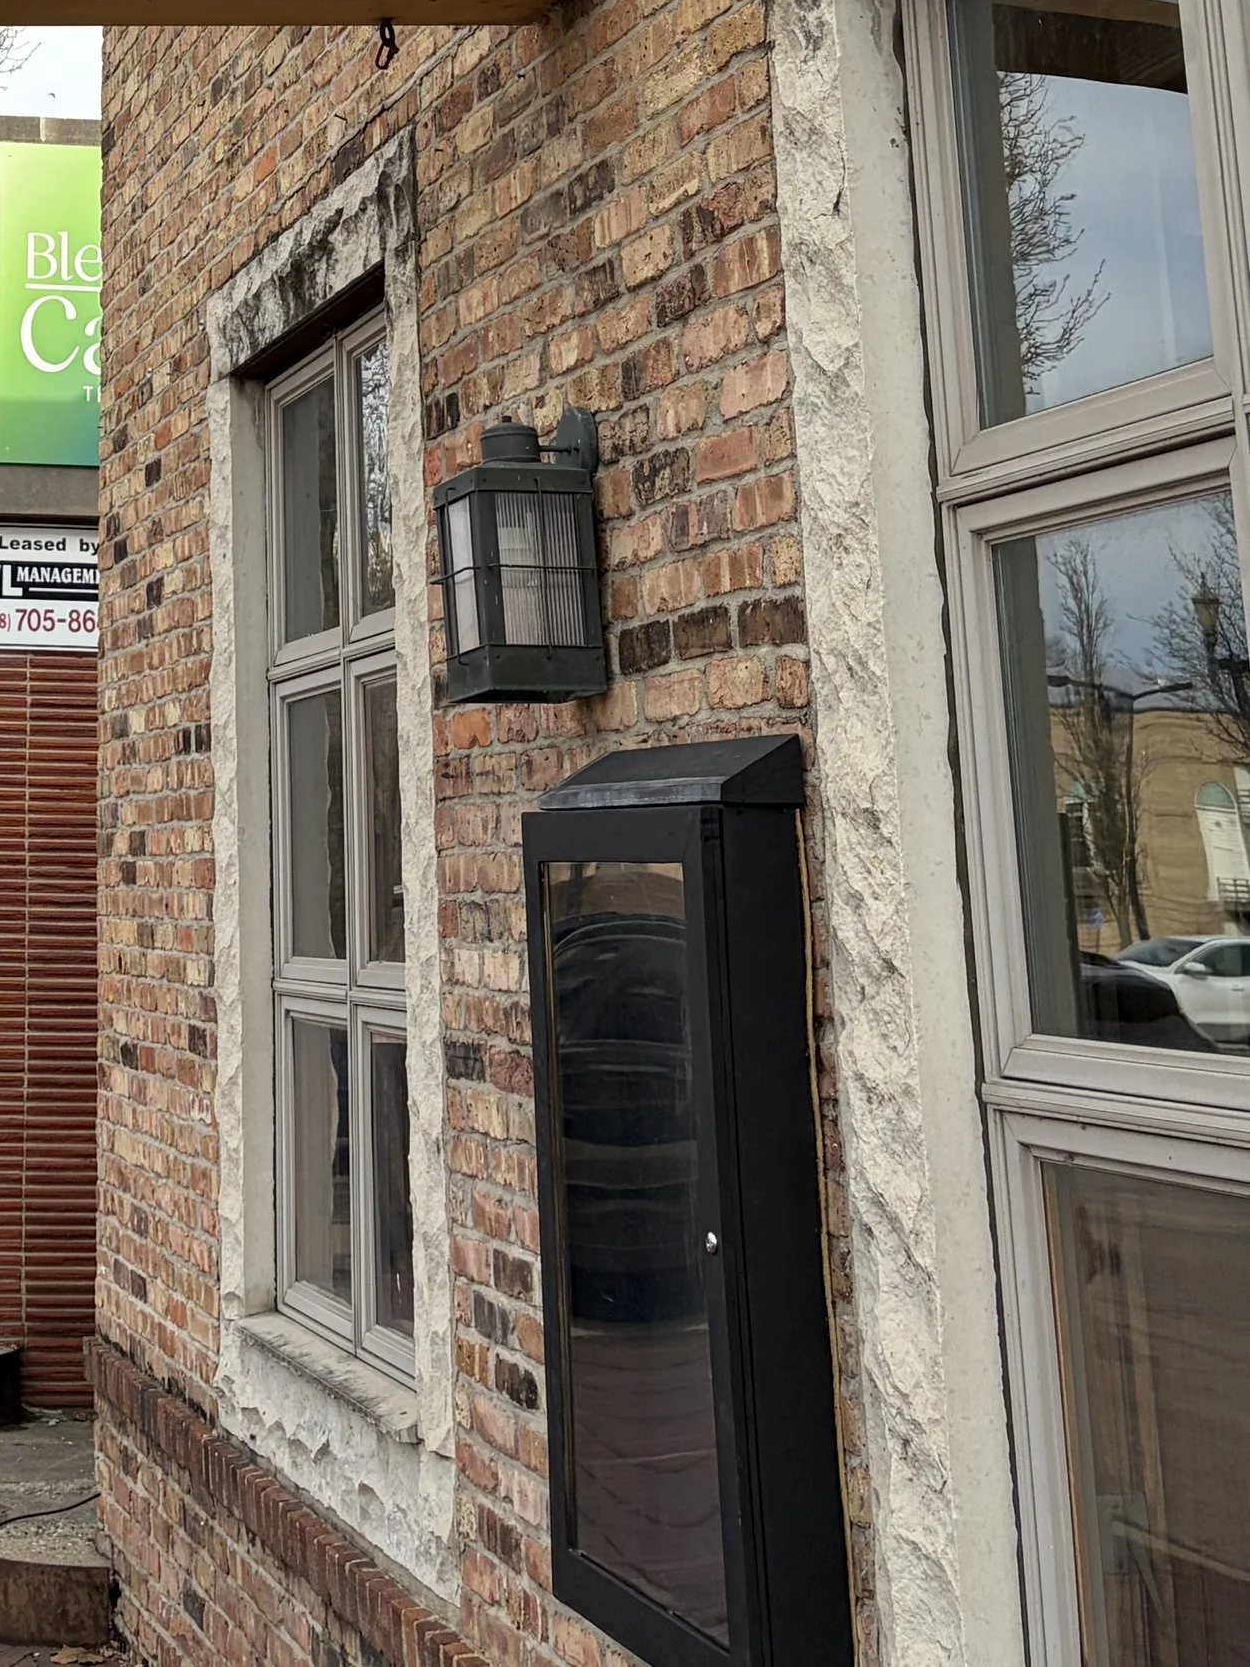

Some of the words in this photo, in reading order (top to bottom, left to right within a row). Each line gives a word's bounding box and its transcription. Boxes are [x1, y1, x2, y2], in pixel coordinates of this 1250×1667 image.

[26, 230, 102, 282] Ble
[78, 538, 100, 556] by
[15, 608, 97, 633] 705-86
